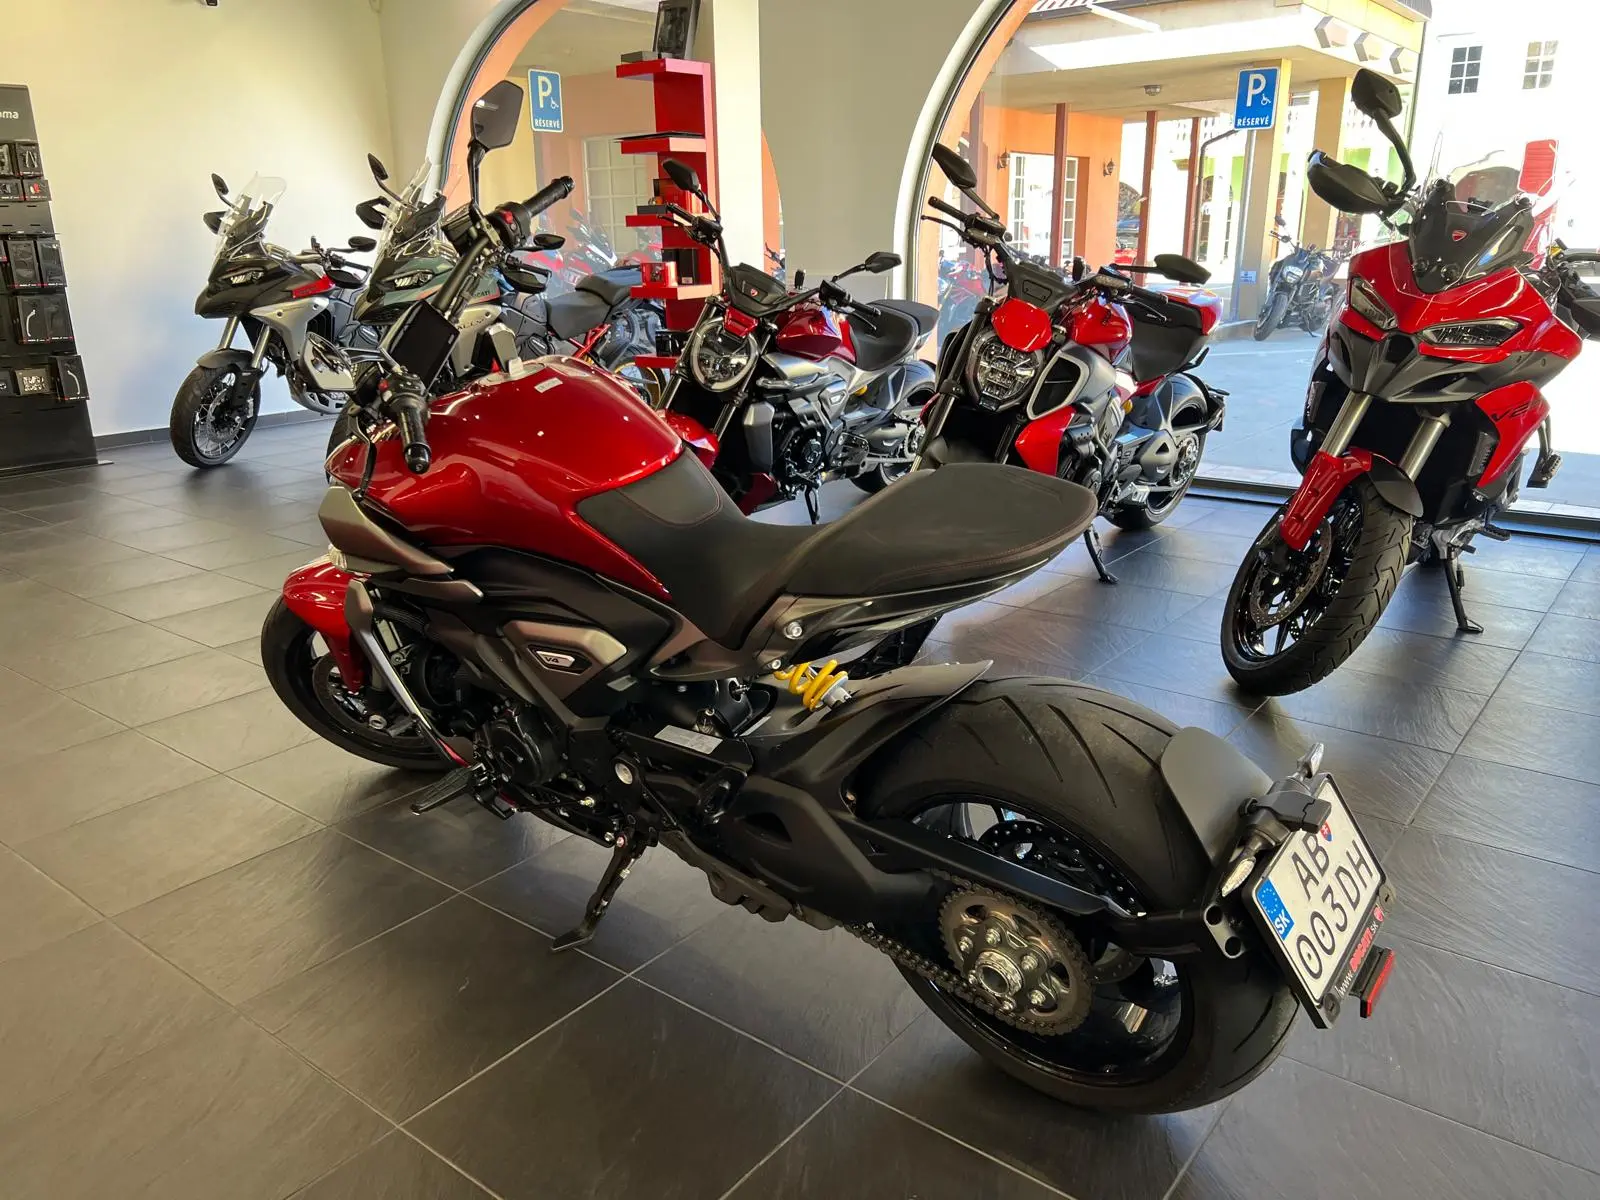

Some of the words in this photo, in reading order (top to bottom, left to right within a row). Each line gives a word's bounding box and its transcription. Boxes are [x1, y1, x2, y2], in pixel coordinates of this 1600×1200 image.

[537, 75, 553, 109] P
[1246, 73, 1267, 107] P
[0, 110, 19, 119] ma
[534, 117, 561, 129] RÉSERVÉ
[1236, 115, 1270, 127] RÉSERVÉ
[1291, 832, 1330, 901] AB
[1273, 910, 1291, 936] SK
[1296, 839, 1374, 980] 003DH
